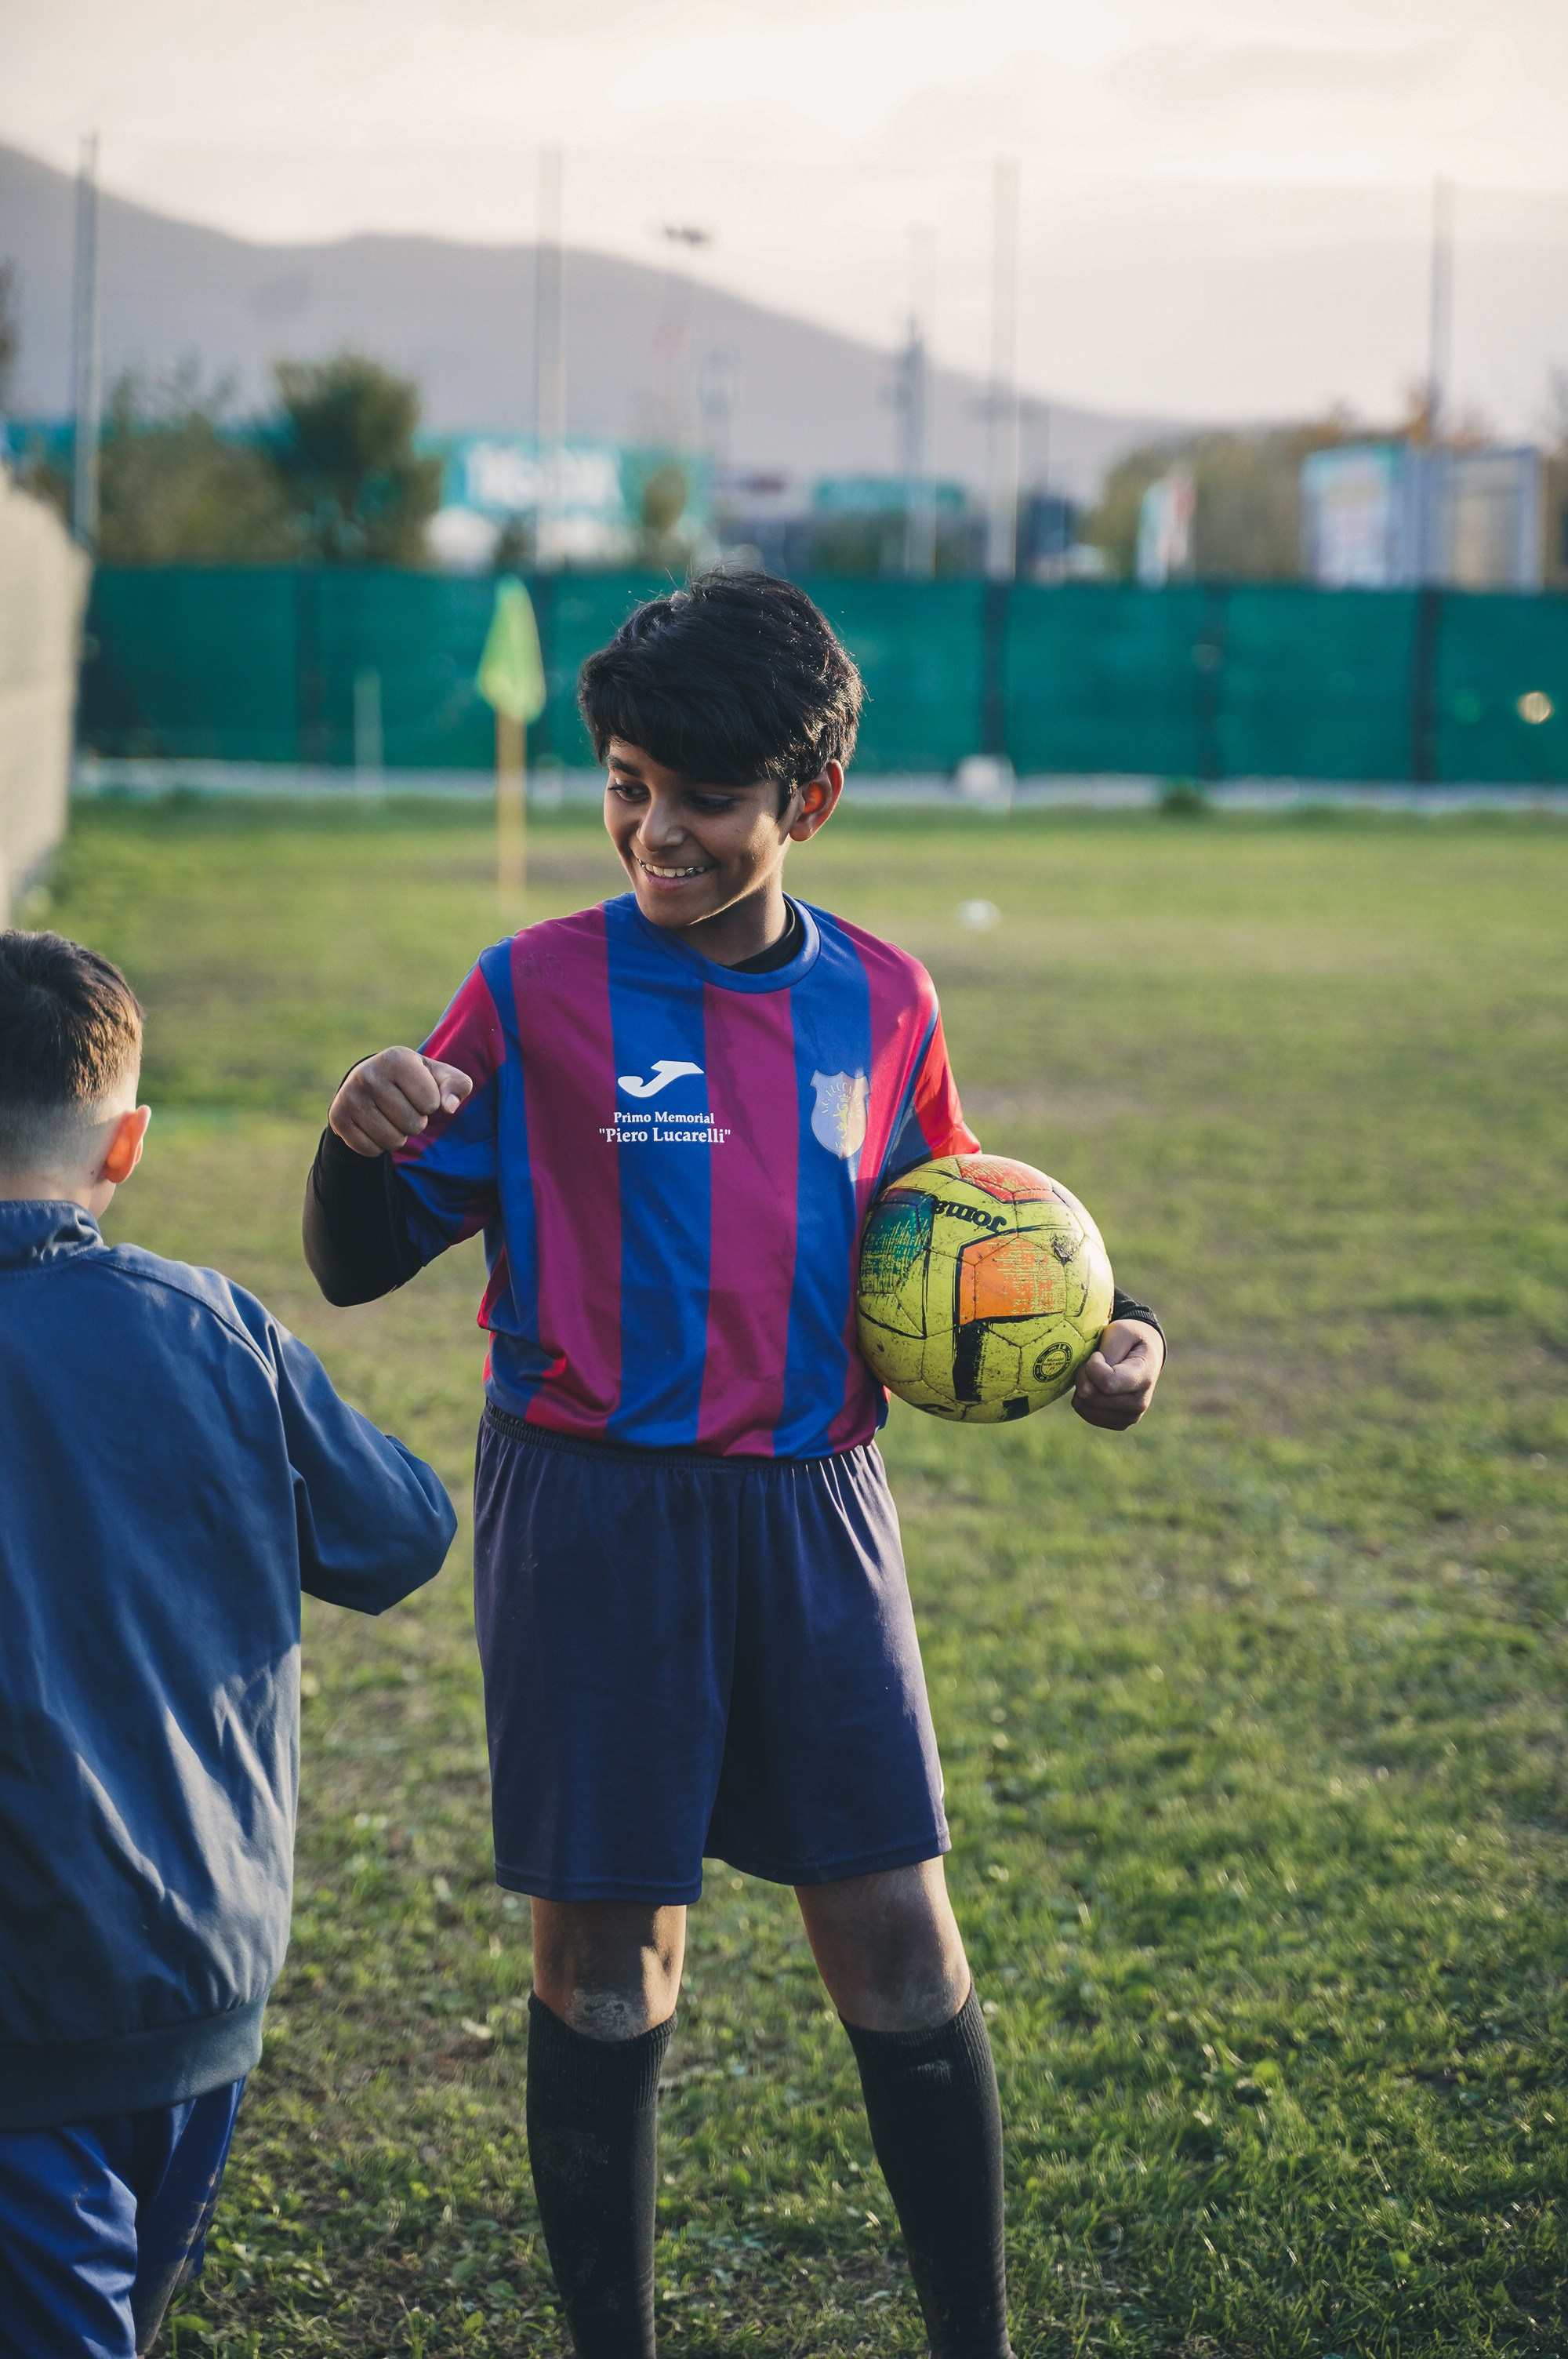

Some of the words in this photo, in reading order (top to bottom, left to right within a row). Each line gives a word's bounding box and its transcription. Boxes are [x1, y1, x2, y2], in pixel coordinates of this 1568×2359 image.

[613, 1111, 652, 1123] Primo
[655, 1111, 715, 1124] Memorial
[599, 1128, 648, 1143] "Piero
[652, 1127, 731, 1143] Lucarelli"
